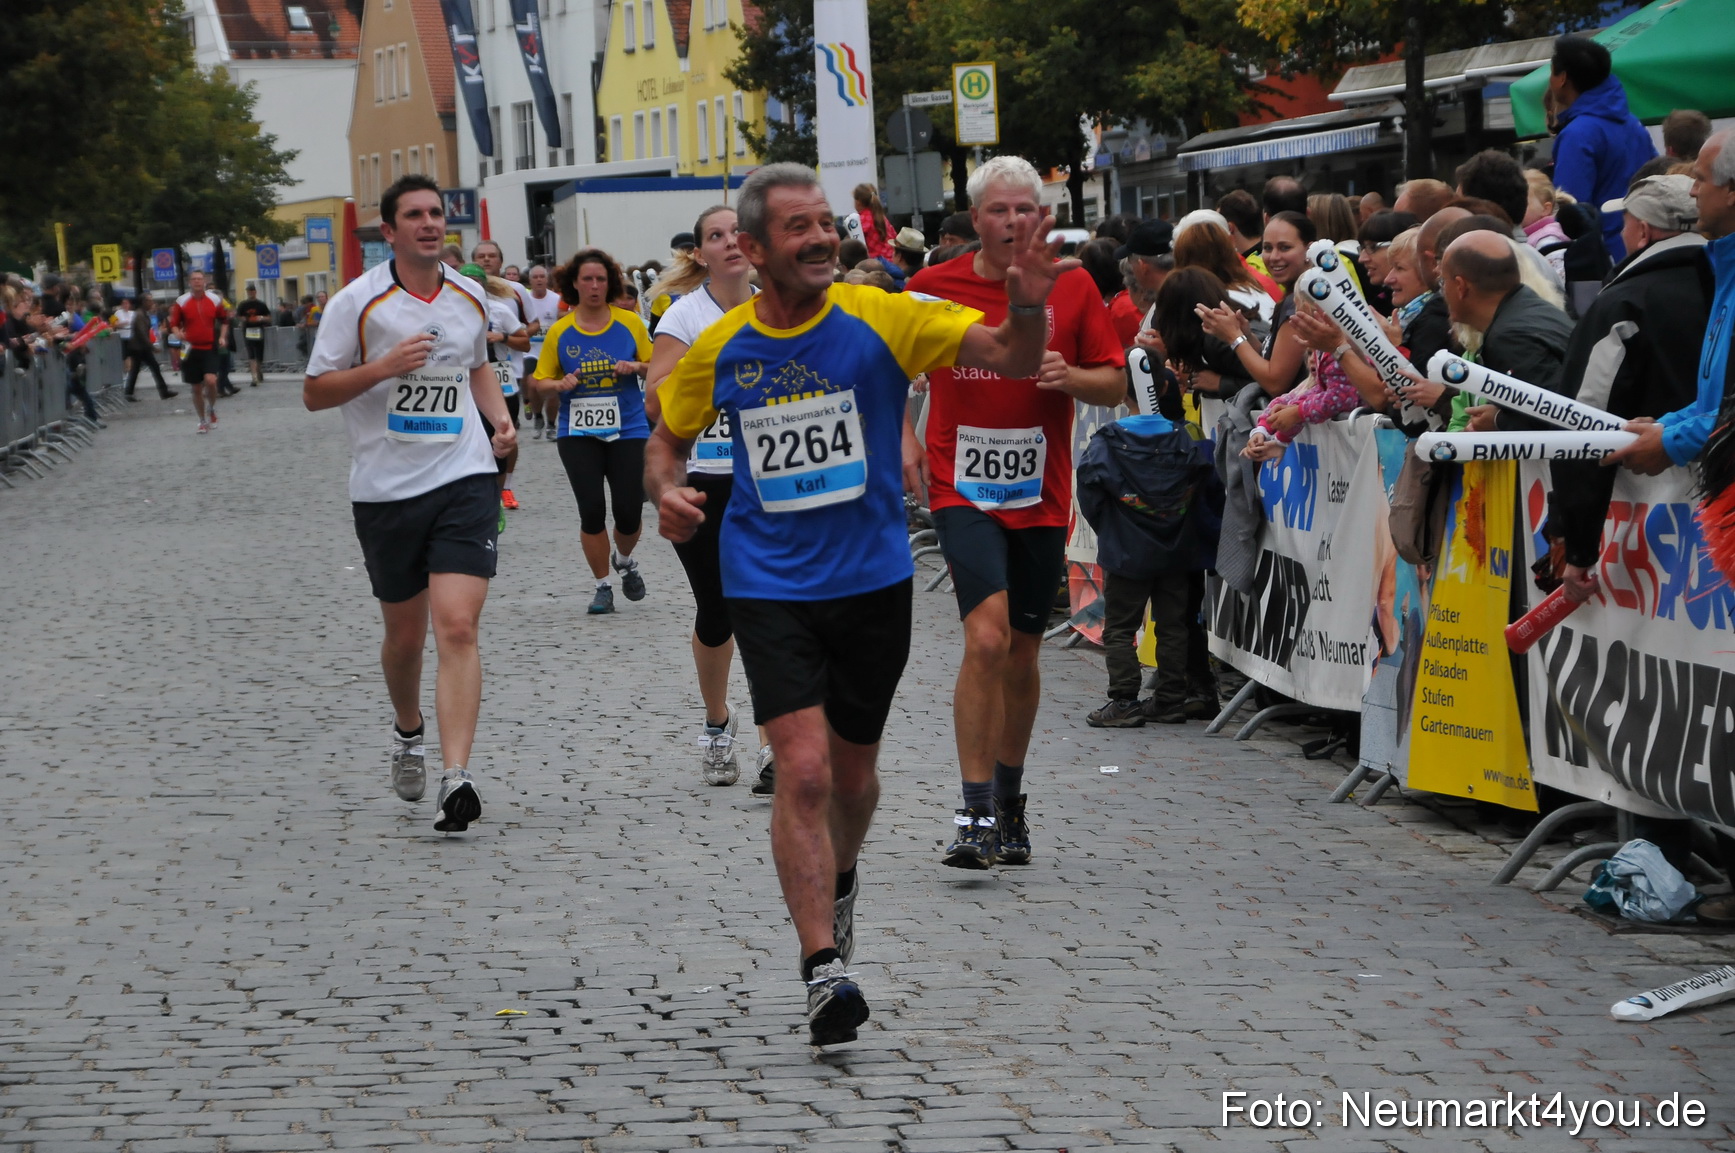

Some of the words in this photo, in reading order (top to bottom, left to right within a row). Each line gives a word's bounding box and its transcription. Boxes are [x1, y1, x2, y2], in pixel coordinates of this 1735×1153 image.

[637, 78, 658, 101] HOTEL
[100, 255, 113, 274] D
[156, 270, 175, 278] TAXI
[259, 268, 279, 277] TAXI
[420, 374, 453, 382] Neumarkt
[395, 384, 458, 413] 2270
[403, 419, 448, 432] Matthias
[574, 408, 616, 427] 2629
[743, 418, 779, 431] PARTL
[781, 405, 836, 424] Neumarkt
[757, 419, 853, 473] 2264
[959, 433, 986, 444] PARTL
[988, 437, 1032, 445] Neumarkt
[965, 447, 1038, 480] 2693
[794, 475, 826, 494] Karl
[1429, 603, 1461, 624] Pflaster
[1318, 630, 1367, 666] Neumar
[1425, 631, 1489, 657] Außenplatten
[1423, 658, 1468, 682] Palisaden
[1421, 686, 1455, 708] Stufen
[1420, 714, 1495, 743] Gartenmauern
